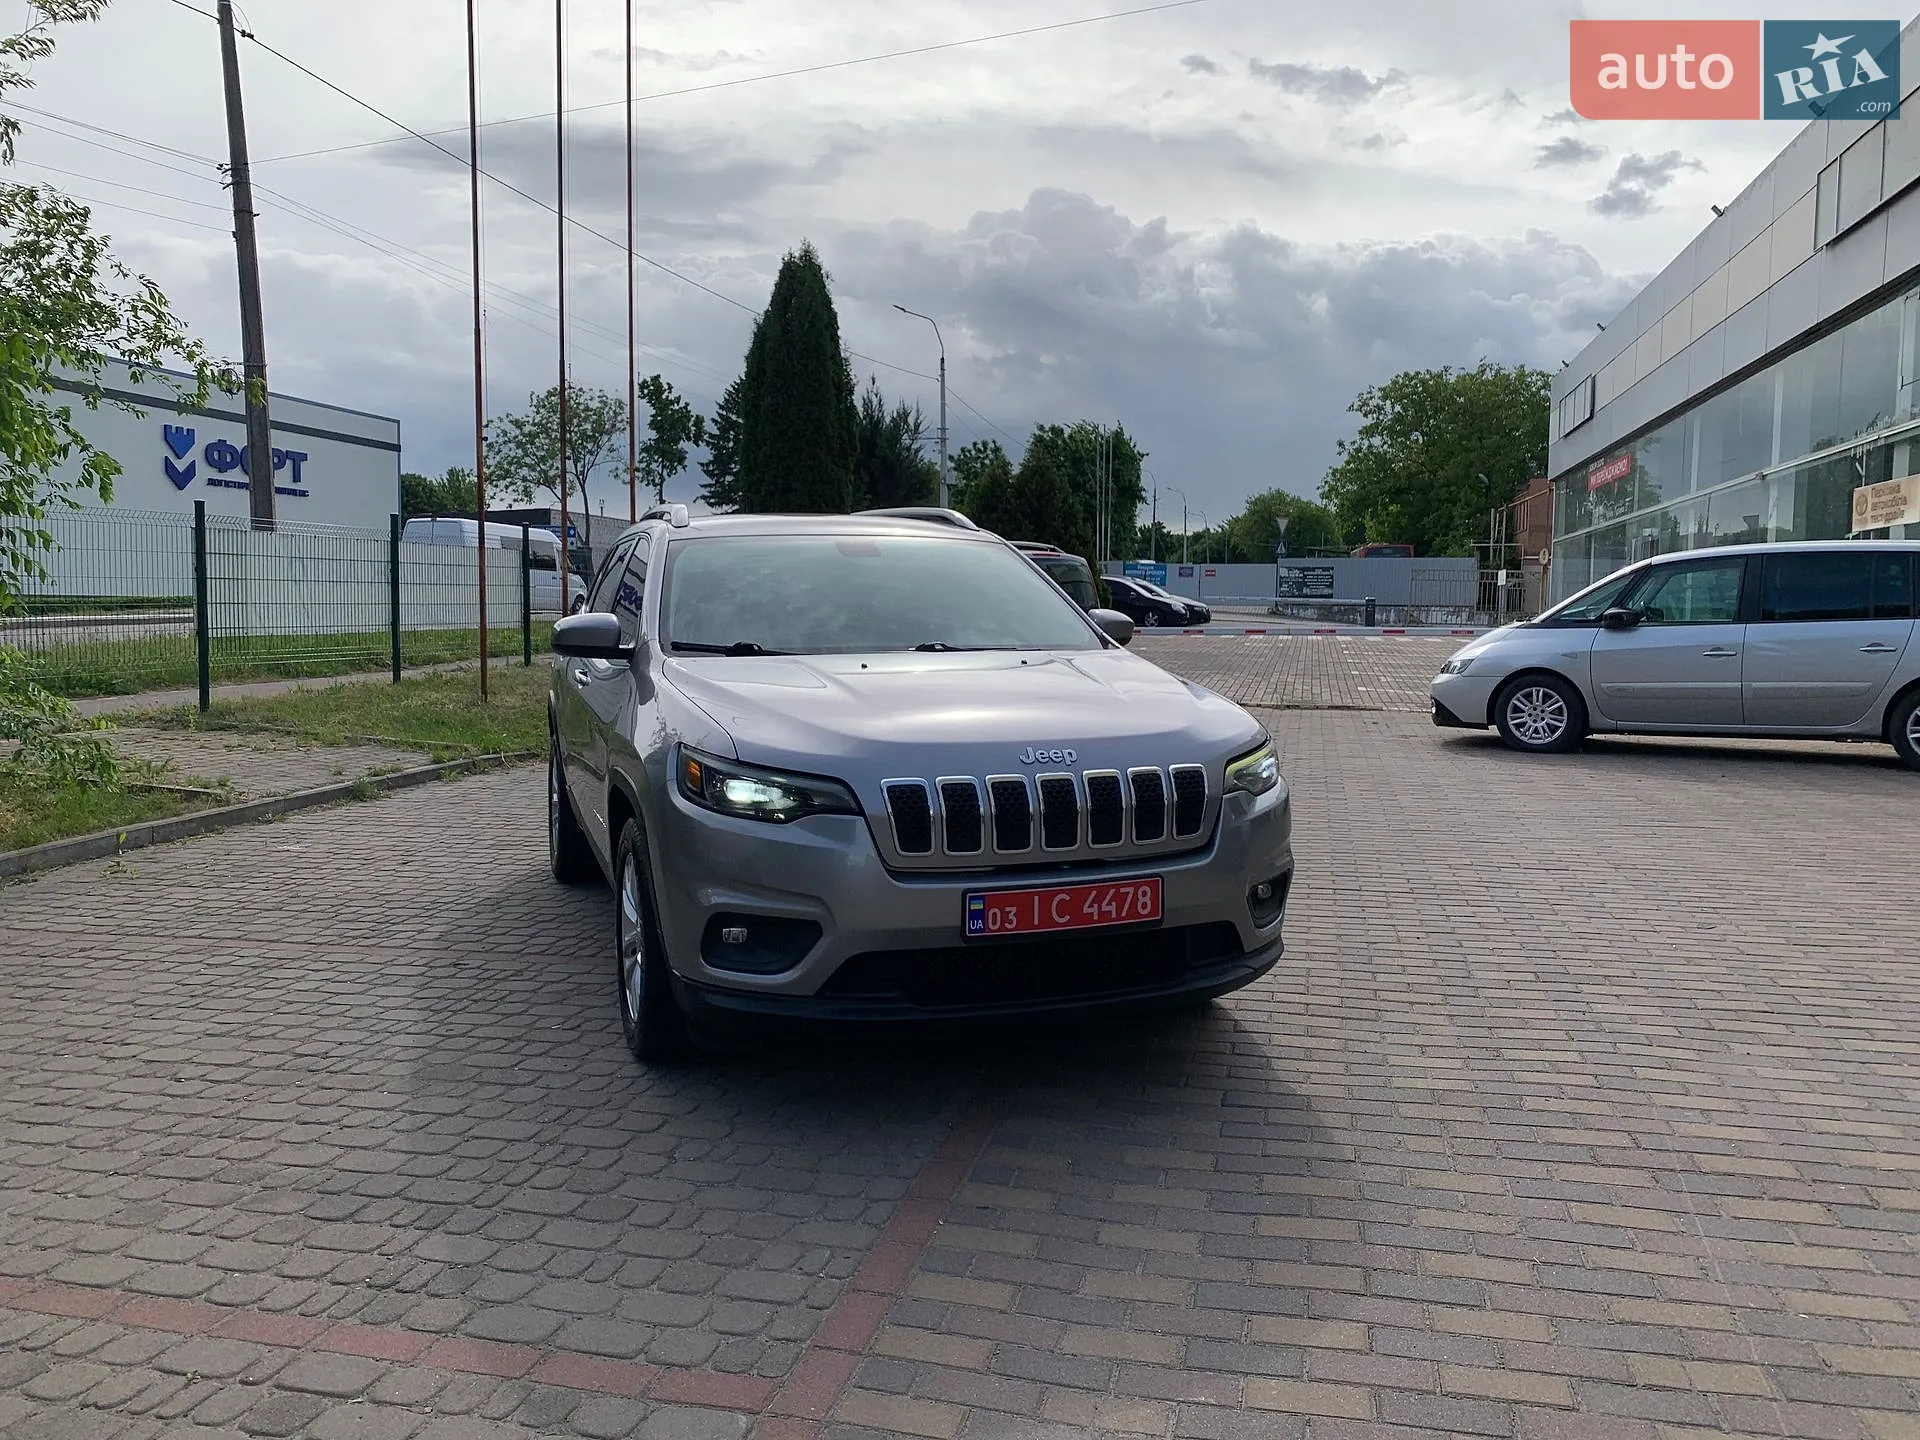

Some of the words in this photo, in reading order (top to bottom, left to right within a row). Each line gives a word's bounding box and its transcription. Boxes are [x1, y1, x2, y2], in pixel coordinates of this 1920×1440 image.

[1019, 746, 1078, 766] Jeep
[987, 906, 1017, 930] 03
[1082, 885, 1152, 920] 4478
[970, 919, 984, 930] UA
